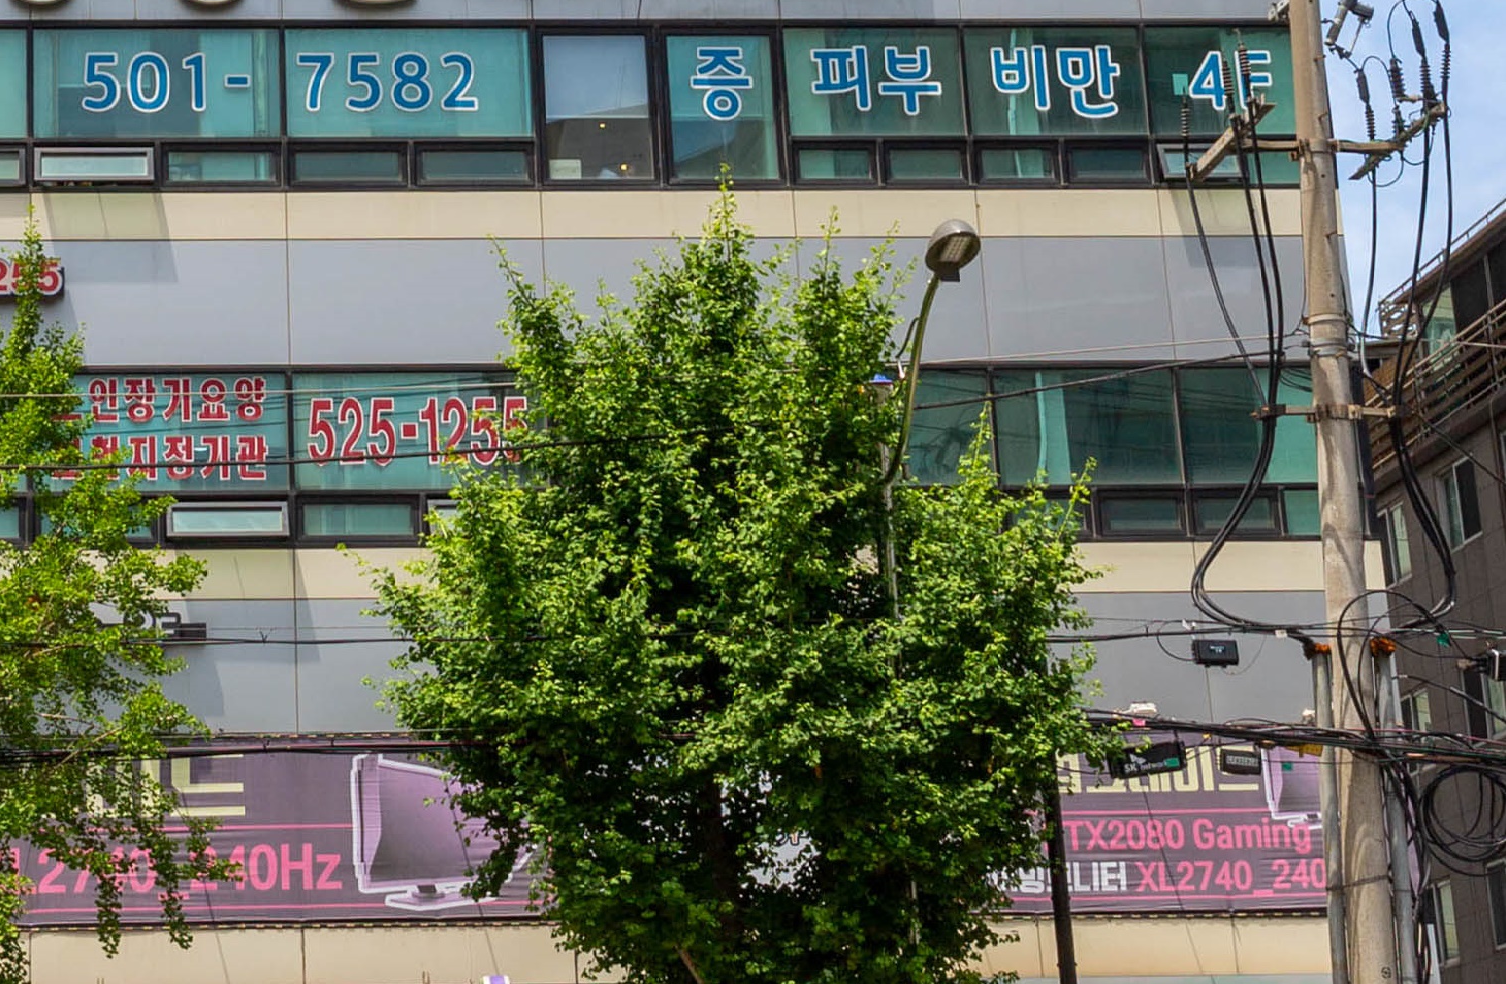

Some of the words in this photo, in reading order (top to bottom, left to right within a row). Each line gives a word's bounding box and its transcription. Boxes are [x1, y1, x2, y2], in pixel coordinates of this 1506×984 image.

[690, 46, 753, 121] 증
[810, 44, 942, 116] 피부
[990, 44, 1120, 119] 비만
[52, 376, 266, 423] 인장기요양
[1060, 818, 1186, 852] TX2080
[1193, 816, 1313, 855] Gaming
